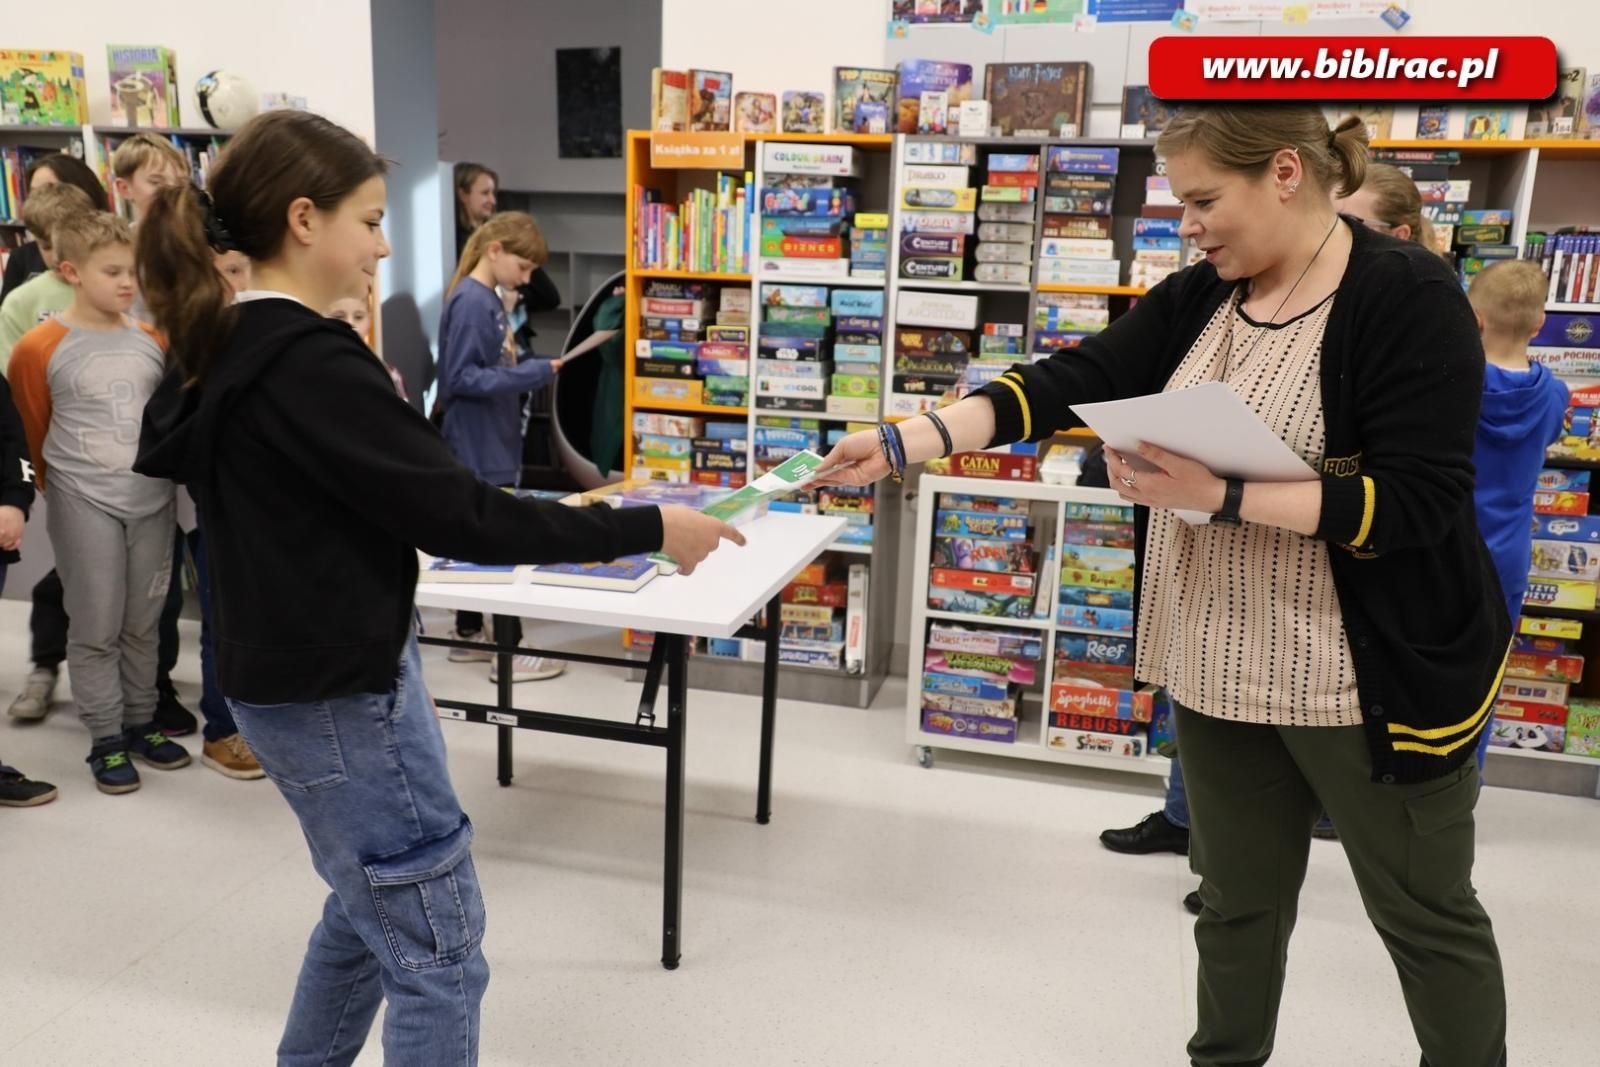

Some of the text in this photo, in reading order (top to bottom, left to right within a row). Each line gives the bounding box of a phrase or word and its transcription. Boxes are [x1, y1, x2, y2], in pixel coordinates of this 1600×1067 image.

[112, 48, 159, 63] HISTORIA
[703, 147, 716, 155] za
[783, 242, 835, 253] BIZNES
[912, 237, 950, 250] CENTURY
[906, 261, 949, 275] CENTURY
[961, 455, 1000, 470] CATAN
[1087, 641, 1127, 659] Reef
[1056, 689, 1112, 707] Spaghetti
[1056, 713, 1131, 734] REBUSY
